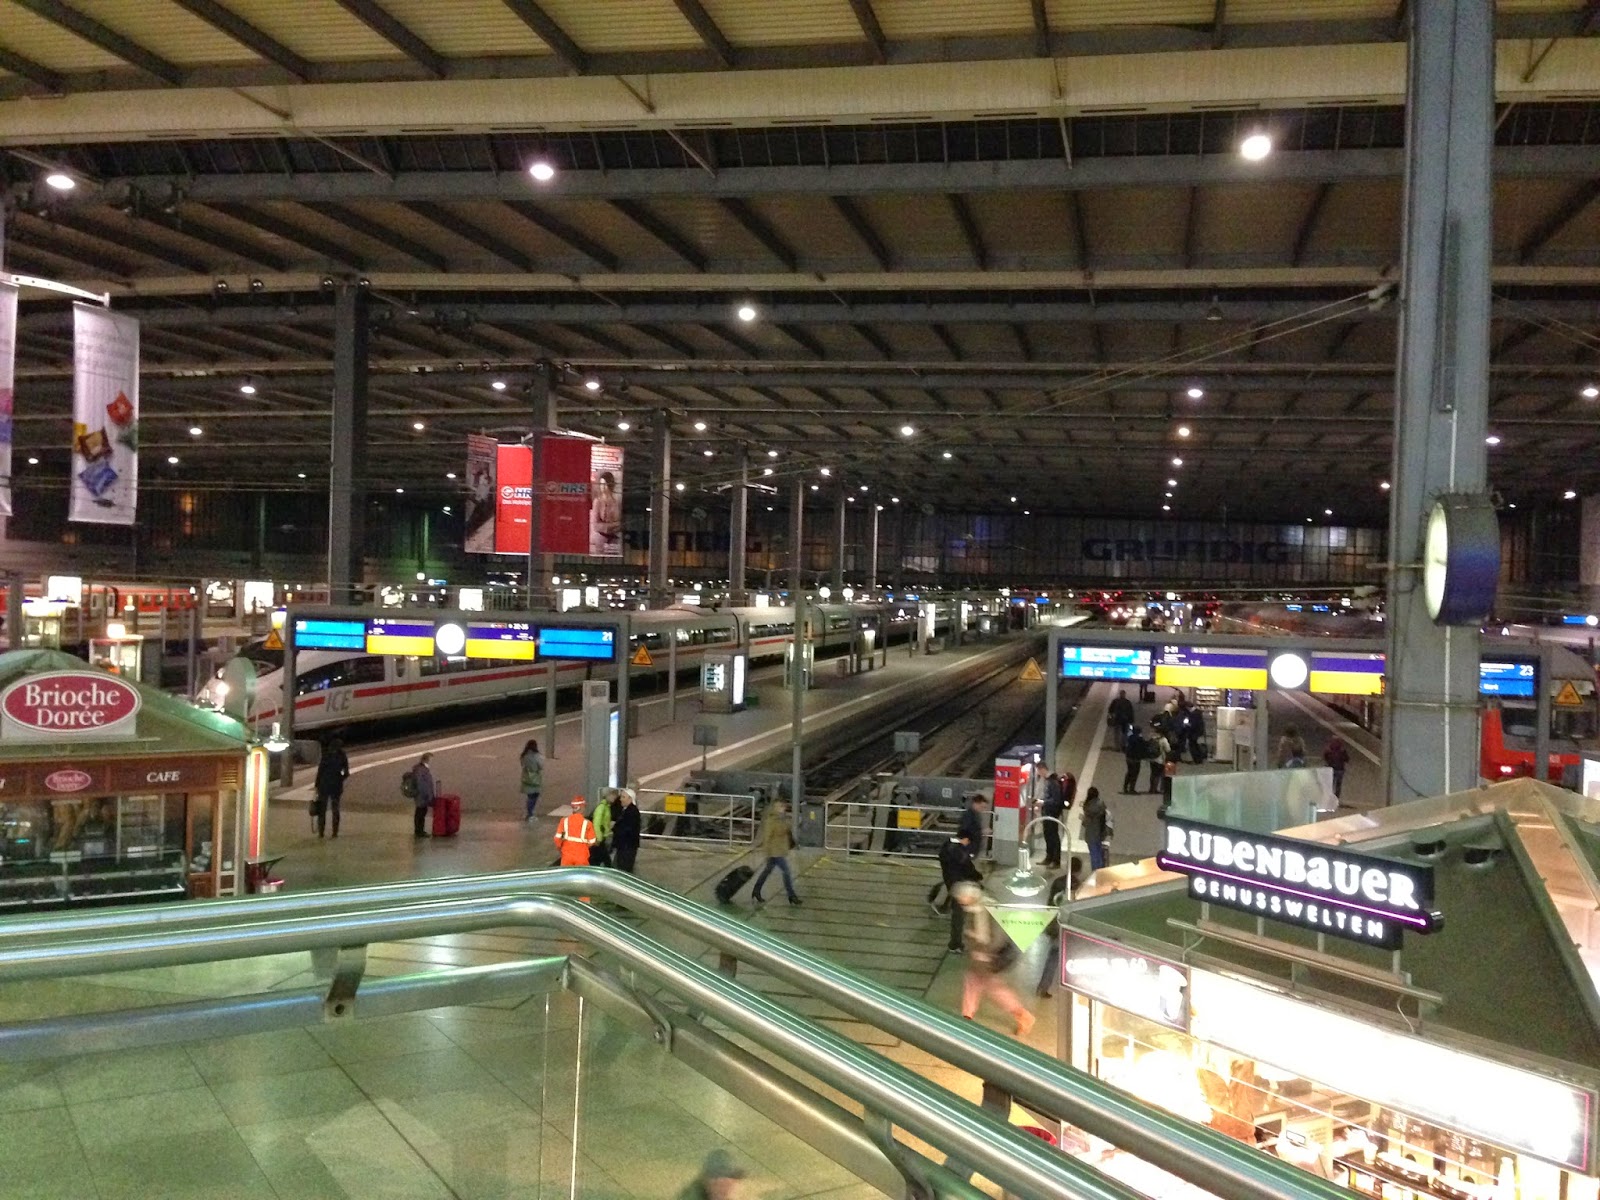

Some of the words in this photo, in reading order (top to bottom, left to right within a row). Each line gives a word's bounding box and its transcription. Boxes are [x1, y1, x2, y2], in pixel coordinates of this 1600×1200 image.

[1083, 538, 1289, 565] GRUNDIG
[602, 631, 612, 641] 21
[1519, 664, 1534, 676] 23
[25, 682, 121, 708] Brioche
[325, 689, 350, 712] ICE
[37, 706, 105, 726] Dorée
[146, 770, 181, 783] CAFE
[1193, 877, 1384, 940] GENUSSWELTEN
